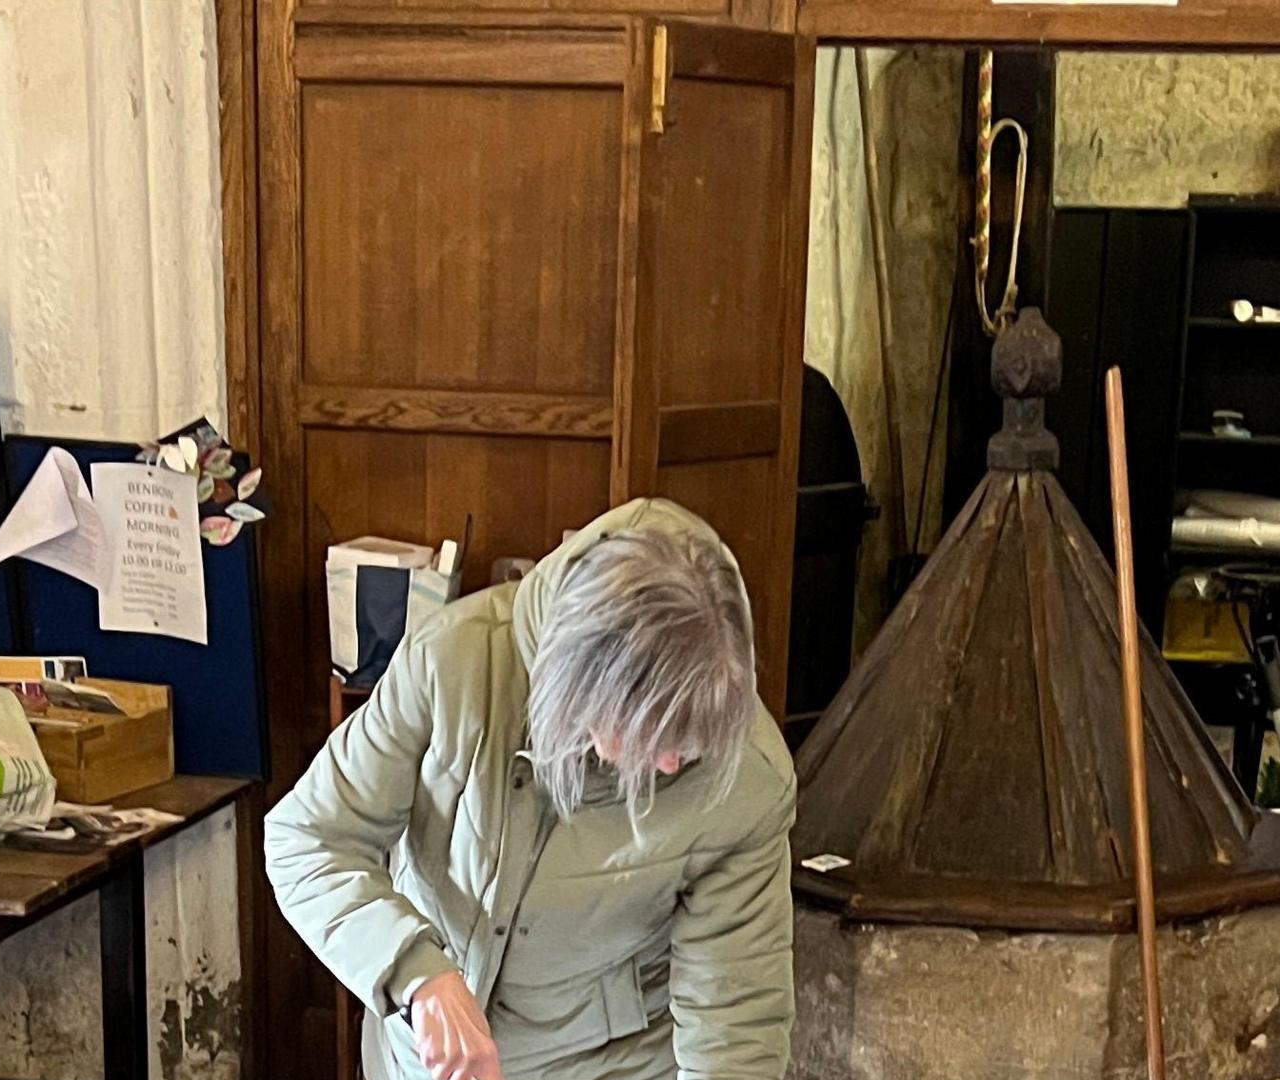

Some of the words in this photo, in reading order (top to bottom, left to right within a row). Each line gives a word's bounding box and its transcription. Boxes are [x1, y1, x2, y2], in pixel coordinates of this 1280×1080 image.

[124, 501, 166, 517] COFFEE
[126, 519, 180, 538] MORNING
[127, 540, 154, 554] Every
